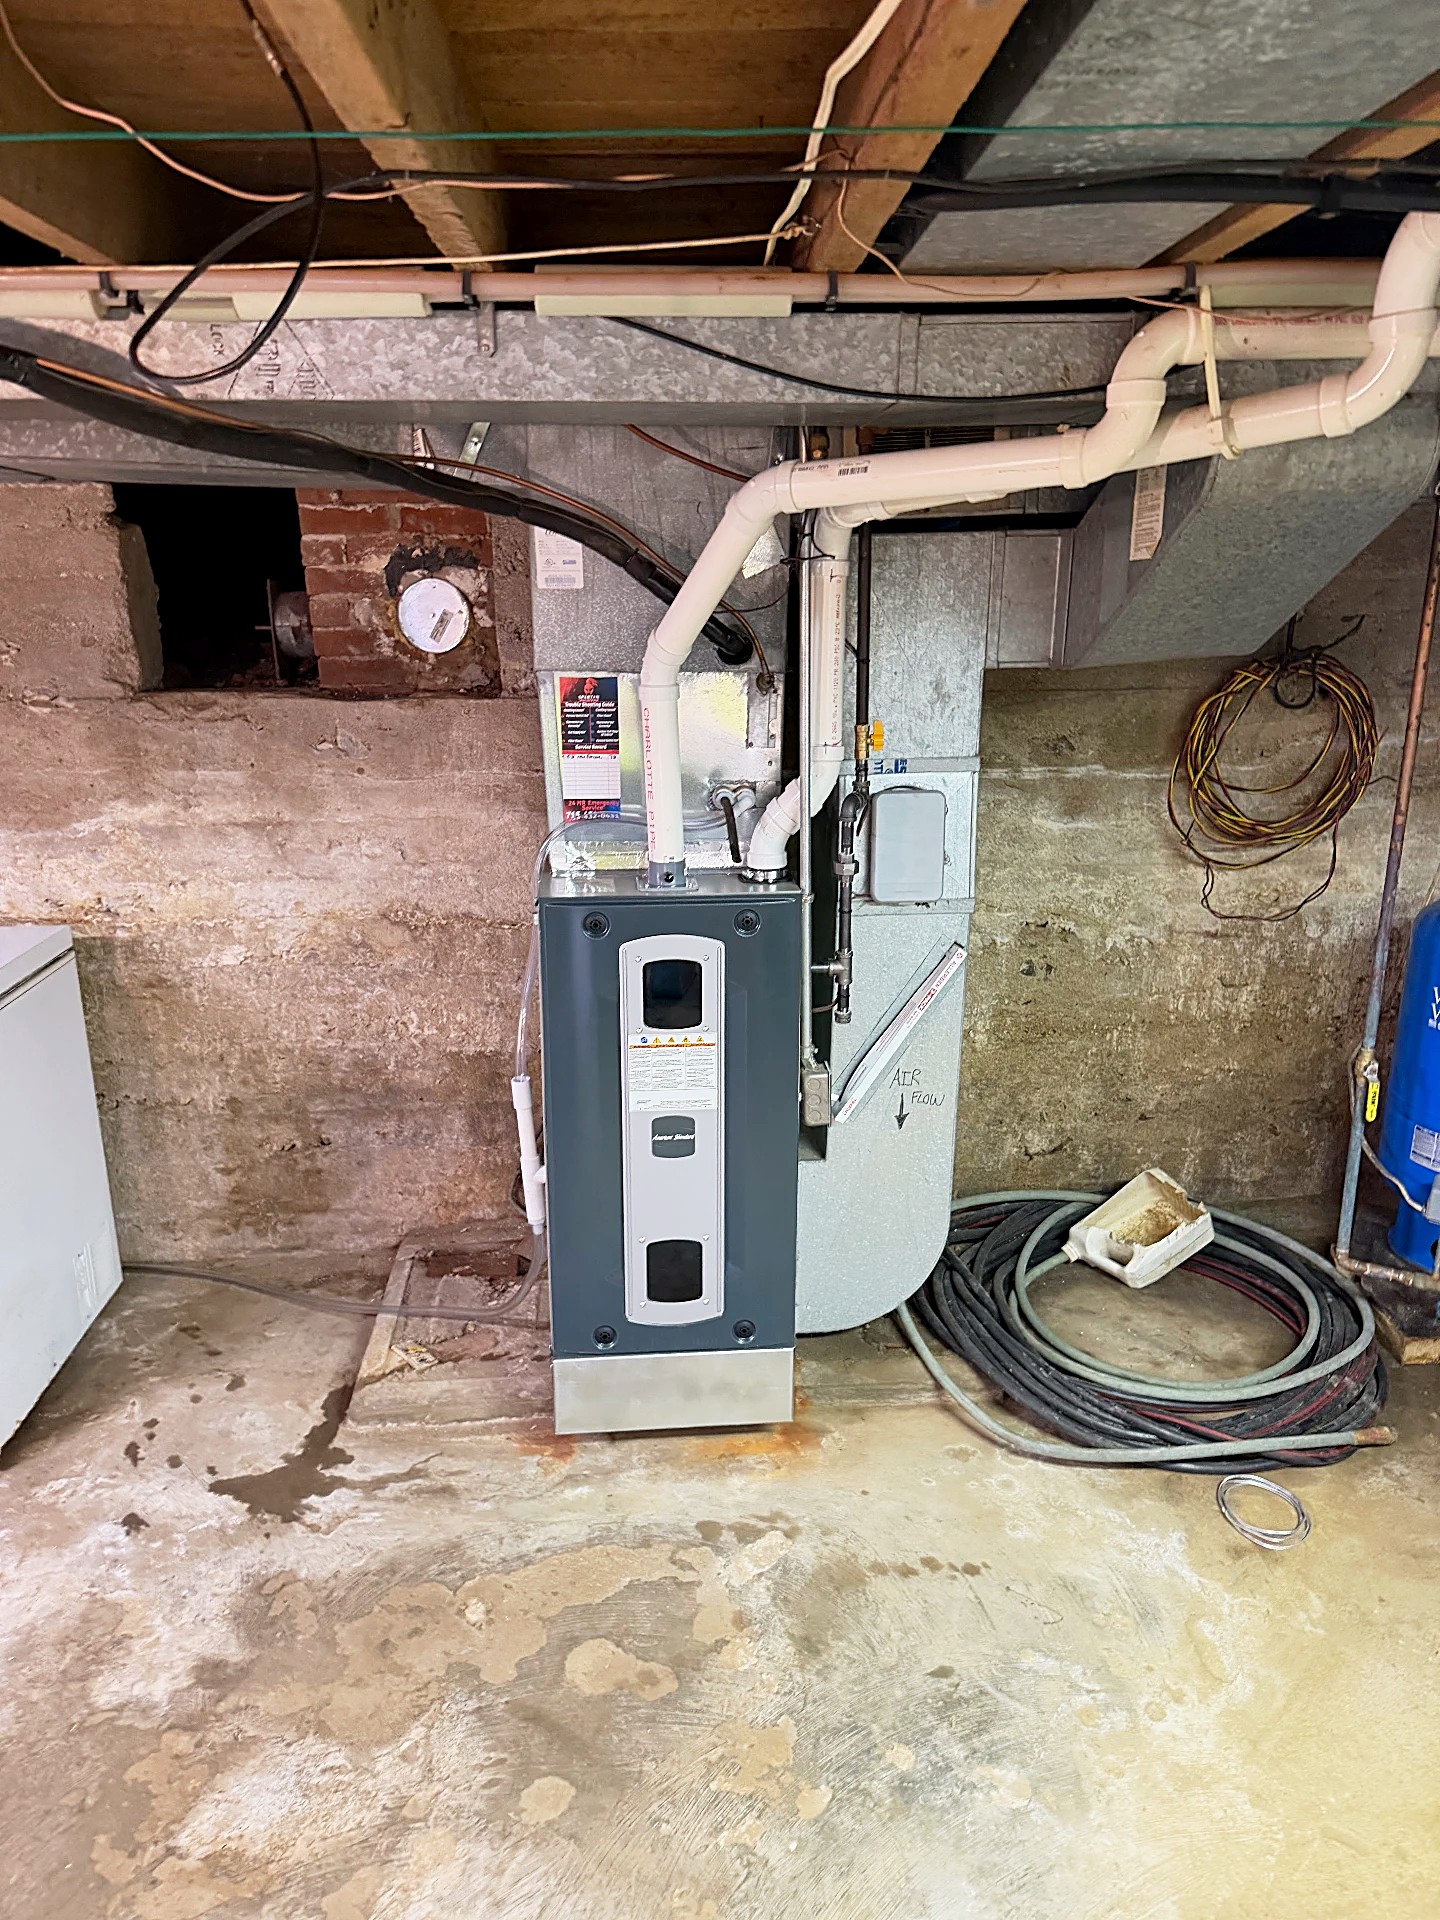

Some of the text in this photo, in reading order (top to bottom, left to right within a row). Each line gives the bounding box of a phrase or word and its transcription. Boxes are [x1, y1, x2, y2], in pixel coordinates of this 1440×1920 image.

[210, 323, 226, 356] LOCK
[643, 707, 657, 850] CHARLOTTE PIPE
[889, 1067, 922, 1089] AIR
[911, 1090, 946, 1107] FLOW
